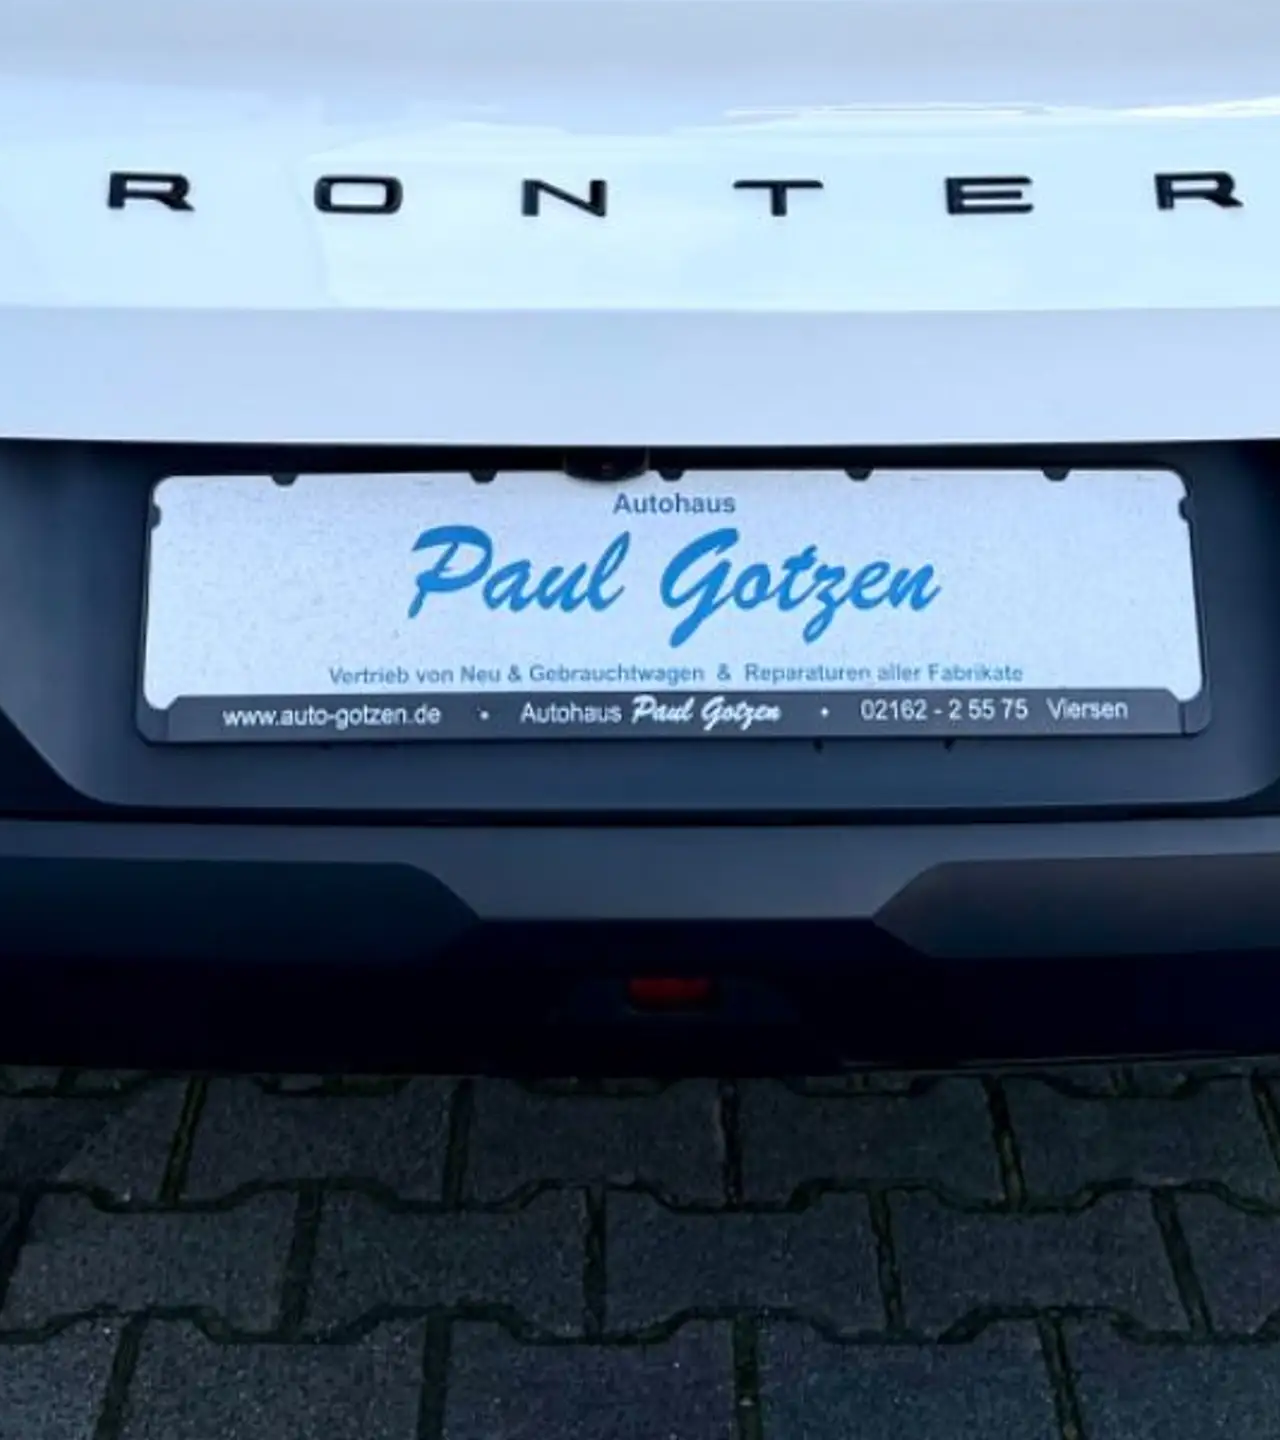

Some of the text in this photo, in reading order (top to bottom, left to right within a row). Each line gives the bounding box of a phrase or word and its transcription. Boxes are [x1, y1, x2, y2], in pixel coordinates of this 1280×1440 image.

[613, 492, 737, 515] Autohaus
[407, 524, 942, 648] Paul Gotzen
[329, 662, 1023, 687] Vertrieb von Neu & Gebrauchtwagen & Reparaturen aller Fabrikate
[222, 703, 442, 730] www.auto-gotzen.de
[520, 694, 782, 731] Autohaus Paul Gotzen
[860, 698, 927, 720] 02162
[949, 698, 962, 720] 2
[969, 697, 995, 720] 55
[1002, 697, 1029, 720] 75
[1046, 696, 1128, 720] Viersen
